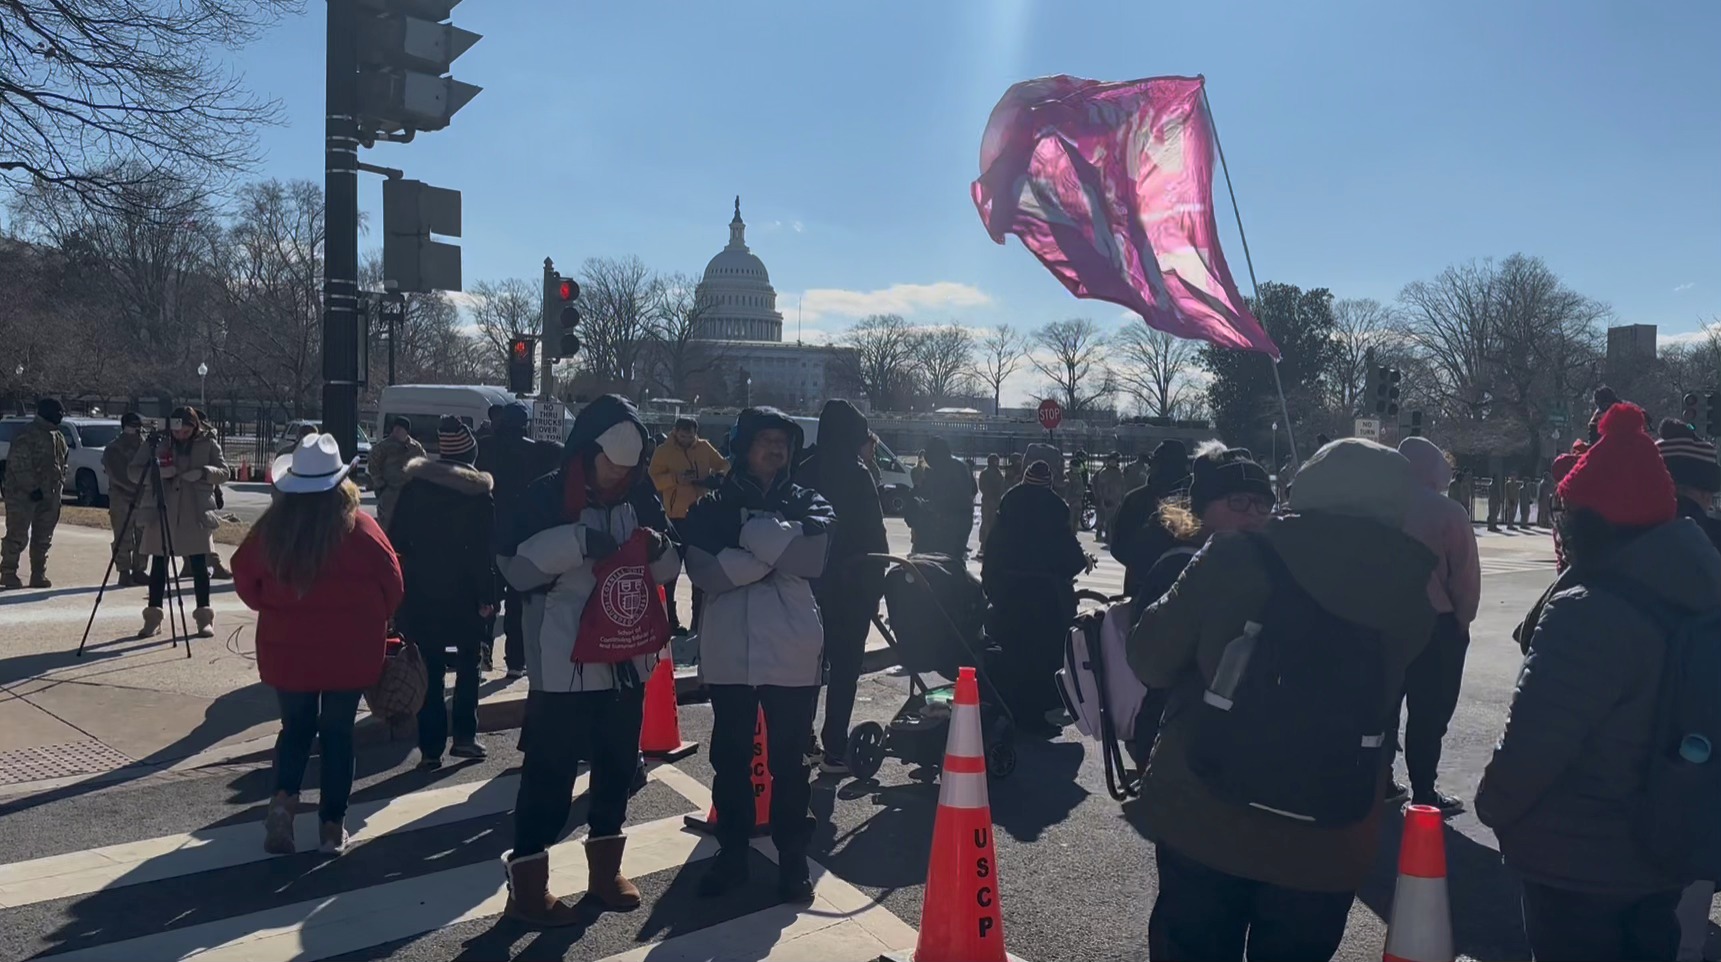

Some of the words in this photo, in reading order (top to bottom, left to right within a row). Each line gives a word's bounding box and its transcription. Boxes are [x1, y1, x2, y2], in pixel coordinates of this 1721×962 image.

[539, 411, 558, 419] THRU
[1040, 408, 1060, 421] STOP
[535, 418, 562, 426] TRUCKS
[539, 426, 557, 434] OVER
[1360, 428, 1376, 436] TURN
[974, 828, 993, 937] USCP
